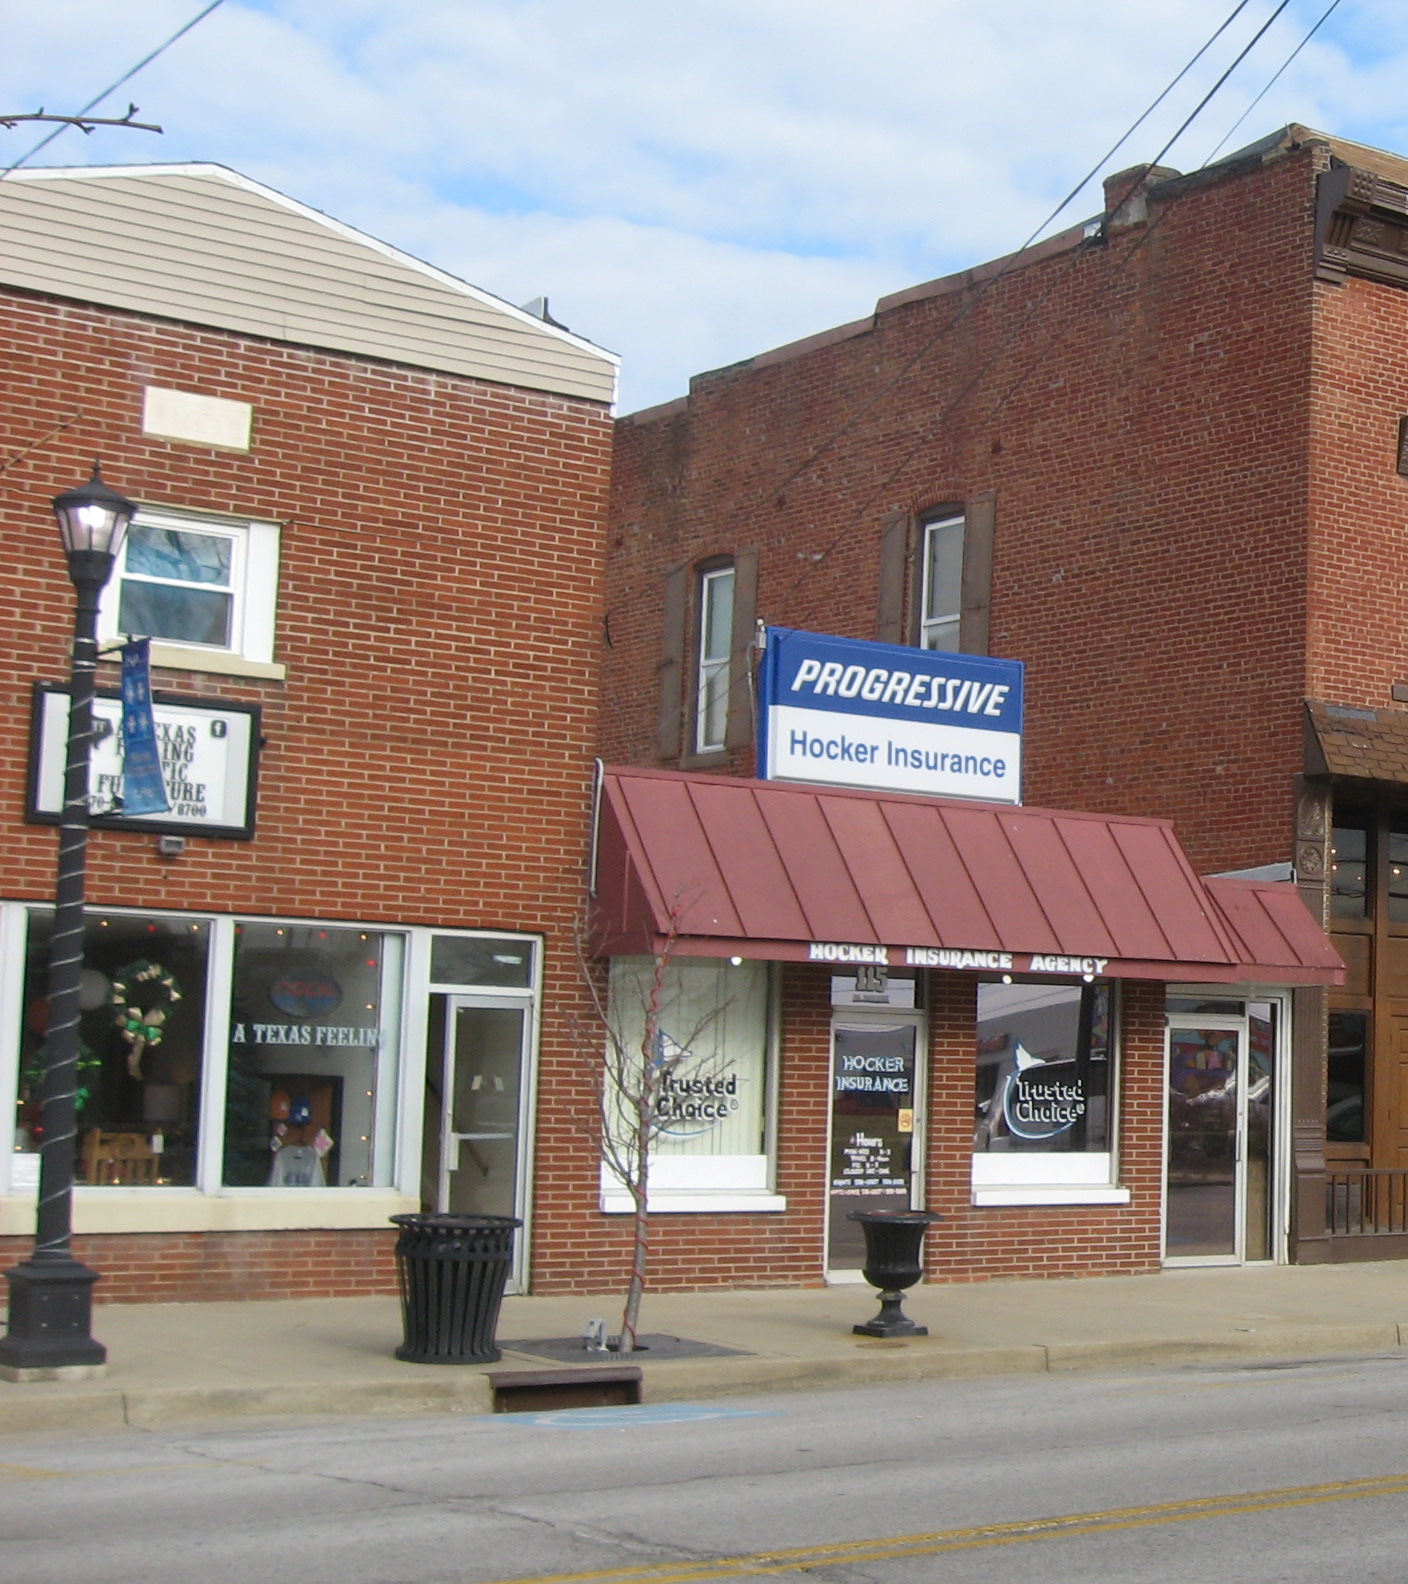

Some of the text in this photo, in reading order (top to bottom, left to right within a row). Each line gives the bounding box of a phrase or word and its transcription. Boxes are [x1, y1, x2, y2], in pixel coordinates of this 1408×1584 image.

[791, 659, 1010, 717] PROGRESSIVE
[790, 729, 1006, 778] Hocker Insurance
[809, 943, 1109, 974] HOCKER INSURANCE AGENCY
[856, 965, 888, 993] 115
[233, 1023, 247, 1043] A
[252, 1024, 311, 1045] TEXAS
[842, 1055, 904, 1073] HOCKER
[660, 1070, 737, 1096] Trusted
[835, 1075, 909, 1093] INSURANCE
[1016, 1079, 1085, 1101] Trusted
[656, 1097, 728, 1120] Choice
[1016, 1101, 1078, 1122] Choice
[856, 1132, 883, 1148] Hours
